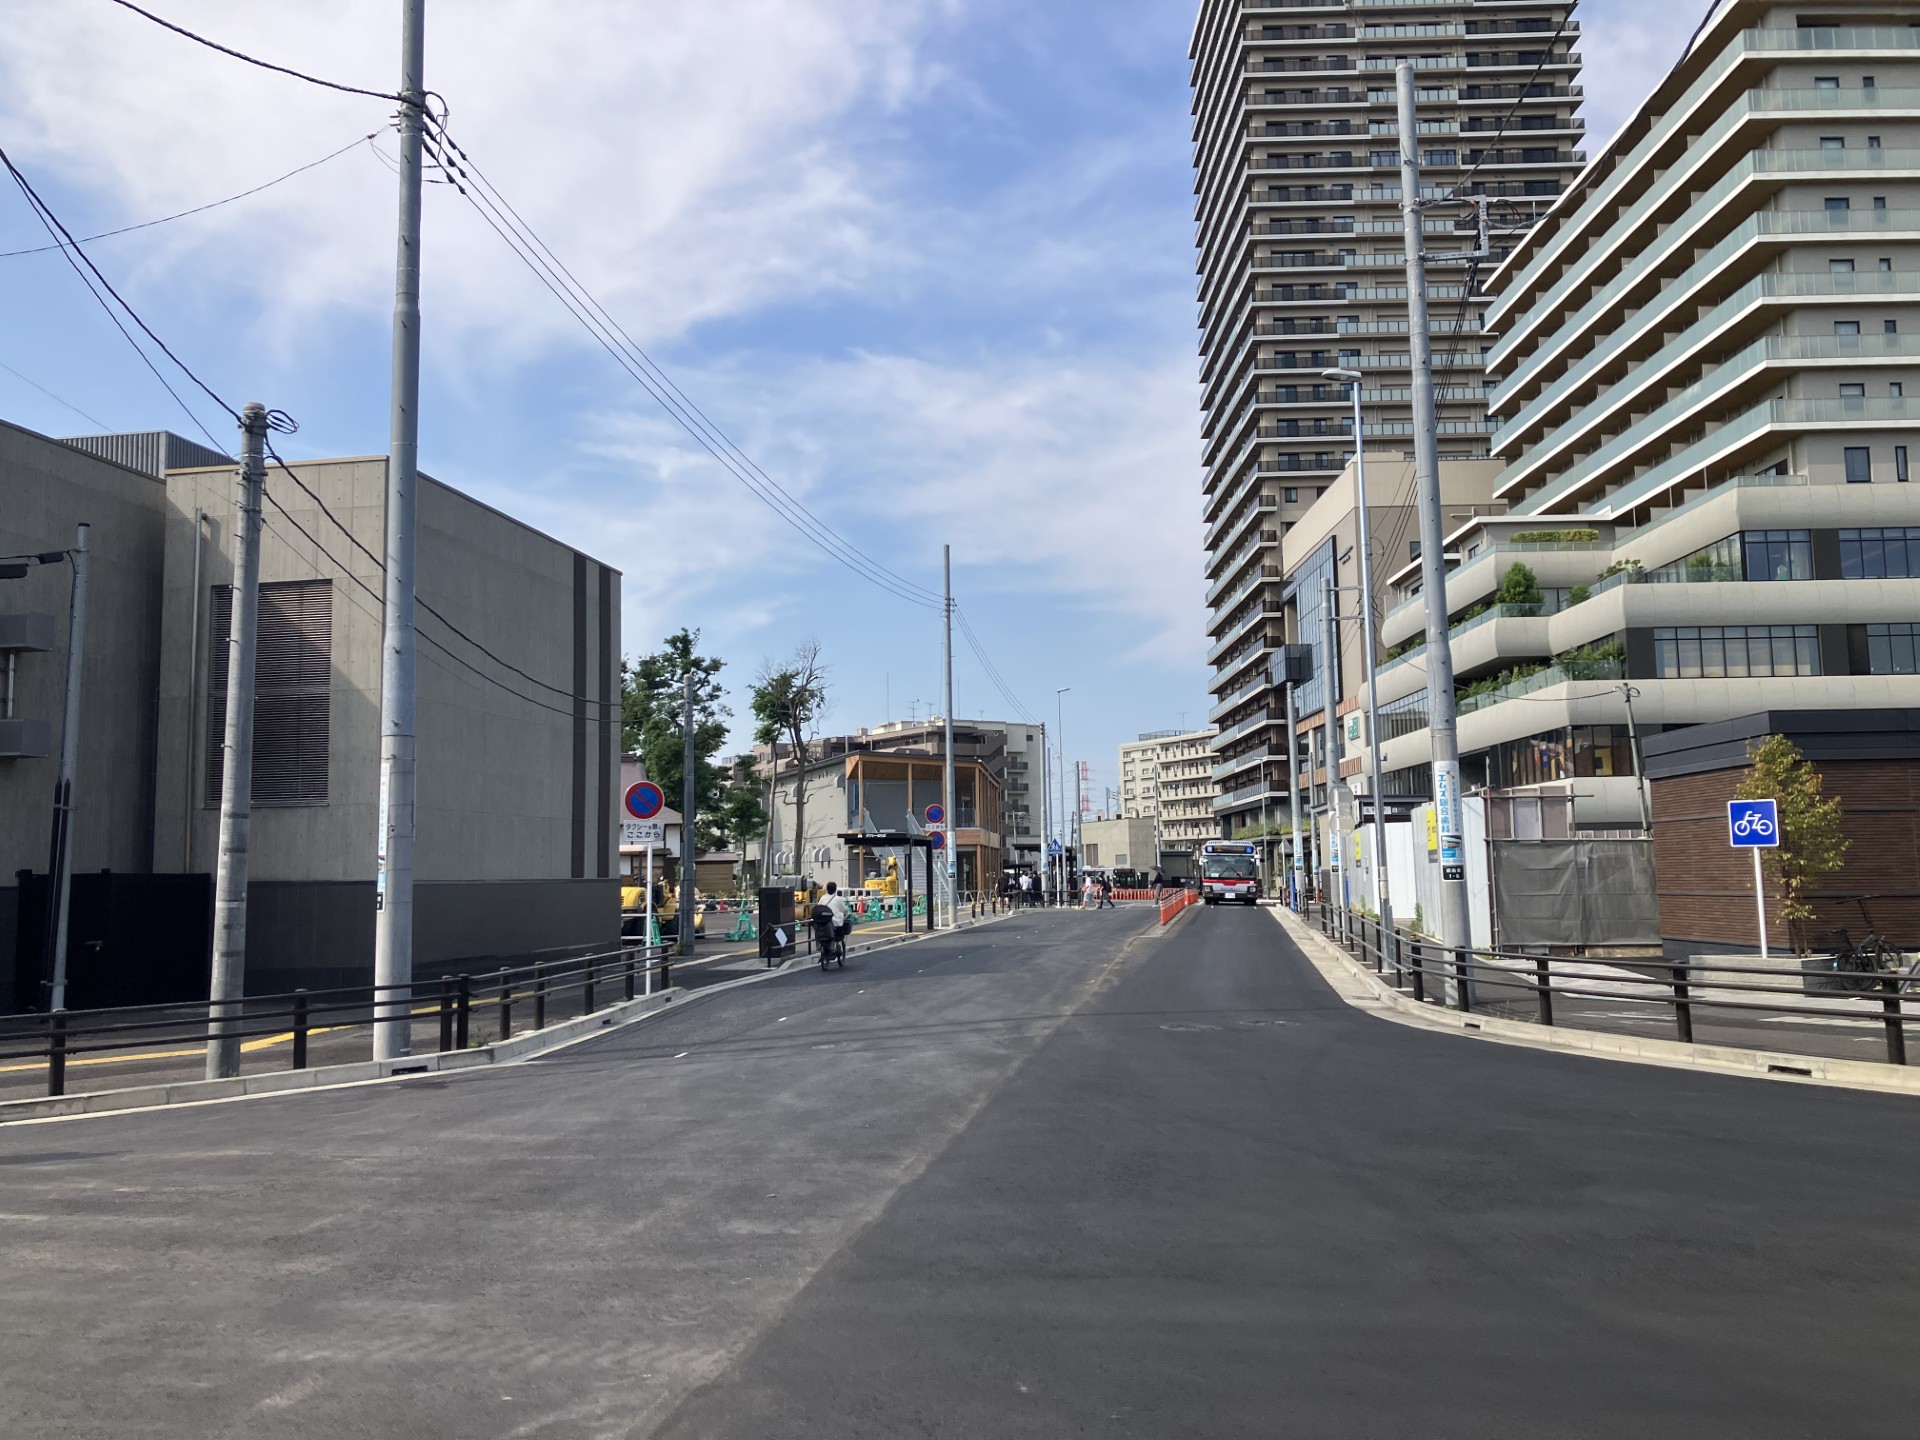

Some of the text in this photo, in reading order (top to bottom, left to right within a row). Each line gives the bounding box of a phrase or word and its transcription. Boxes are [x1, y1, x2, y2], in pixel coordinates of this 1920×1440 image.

[1438, 774, 1450, 833] エムス総合歯科
